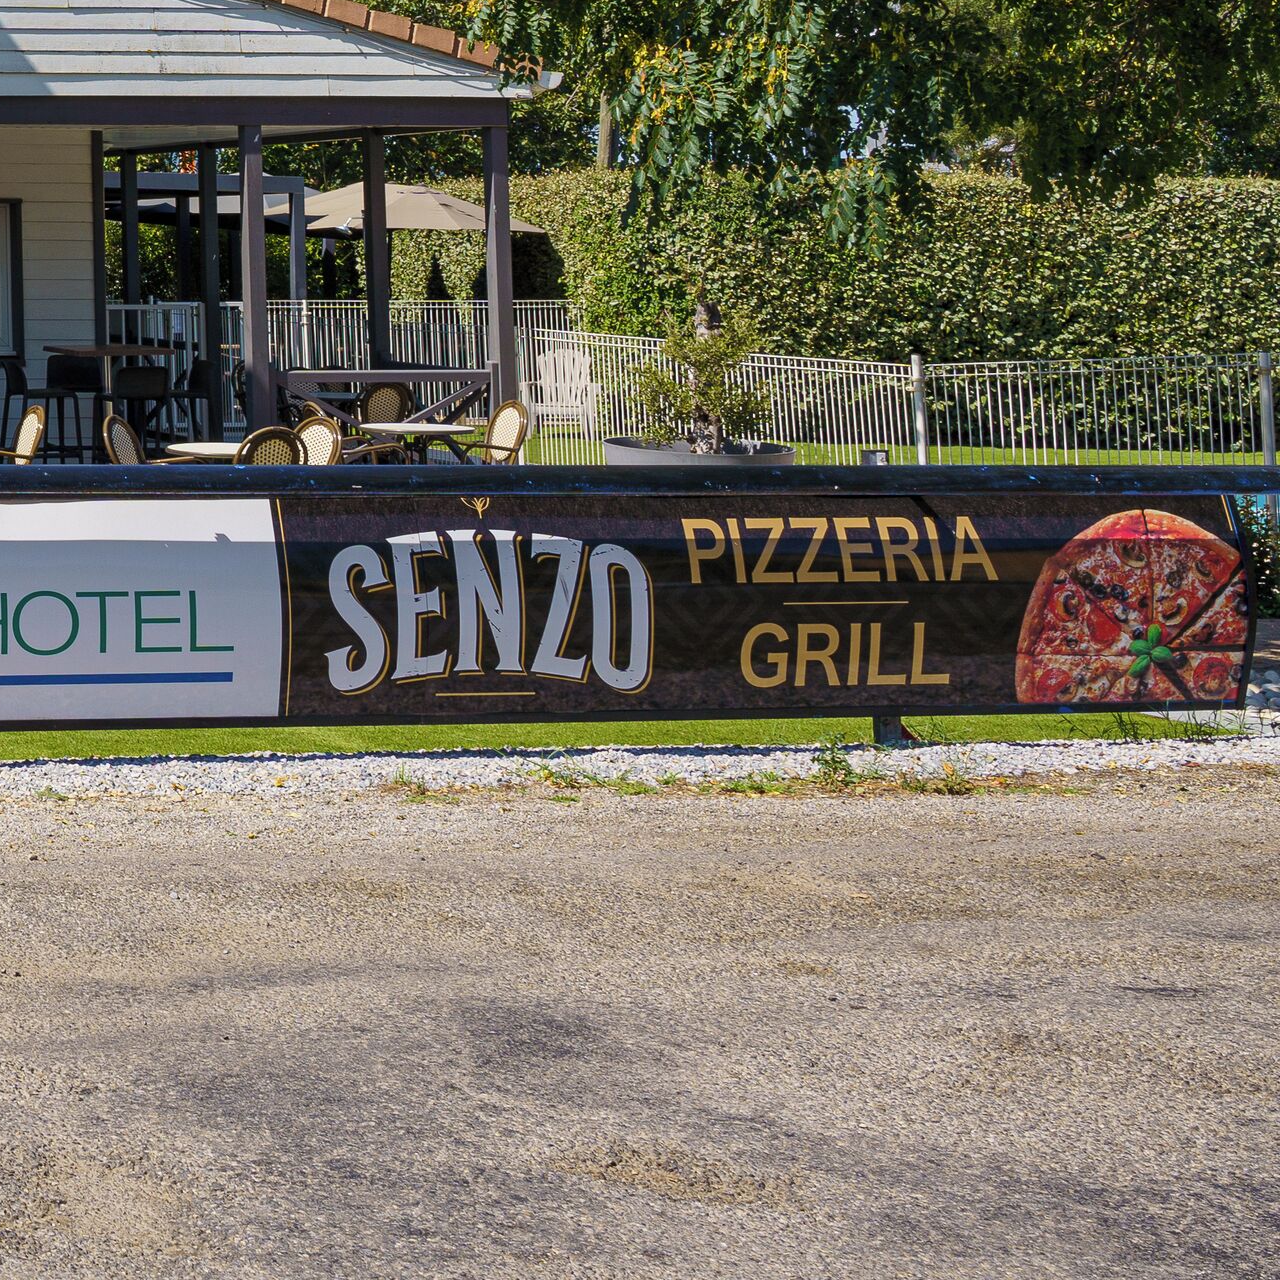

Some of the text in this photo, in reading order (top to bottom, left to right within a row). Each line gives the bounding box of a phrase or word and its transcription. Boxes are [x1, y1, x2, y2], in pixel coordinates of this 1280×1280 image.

[681, 516, 999, 584] PIZZERIA
[324, 529, 654, 695] SENZO
[740, 622, 950, 688] GRILL
